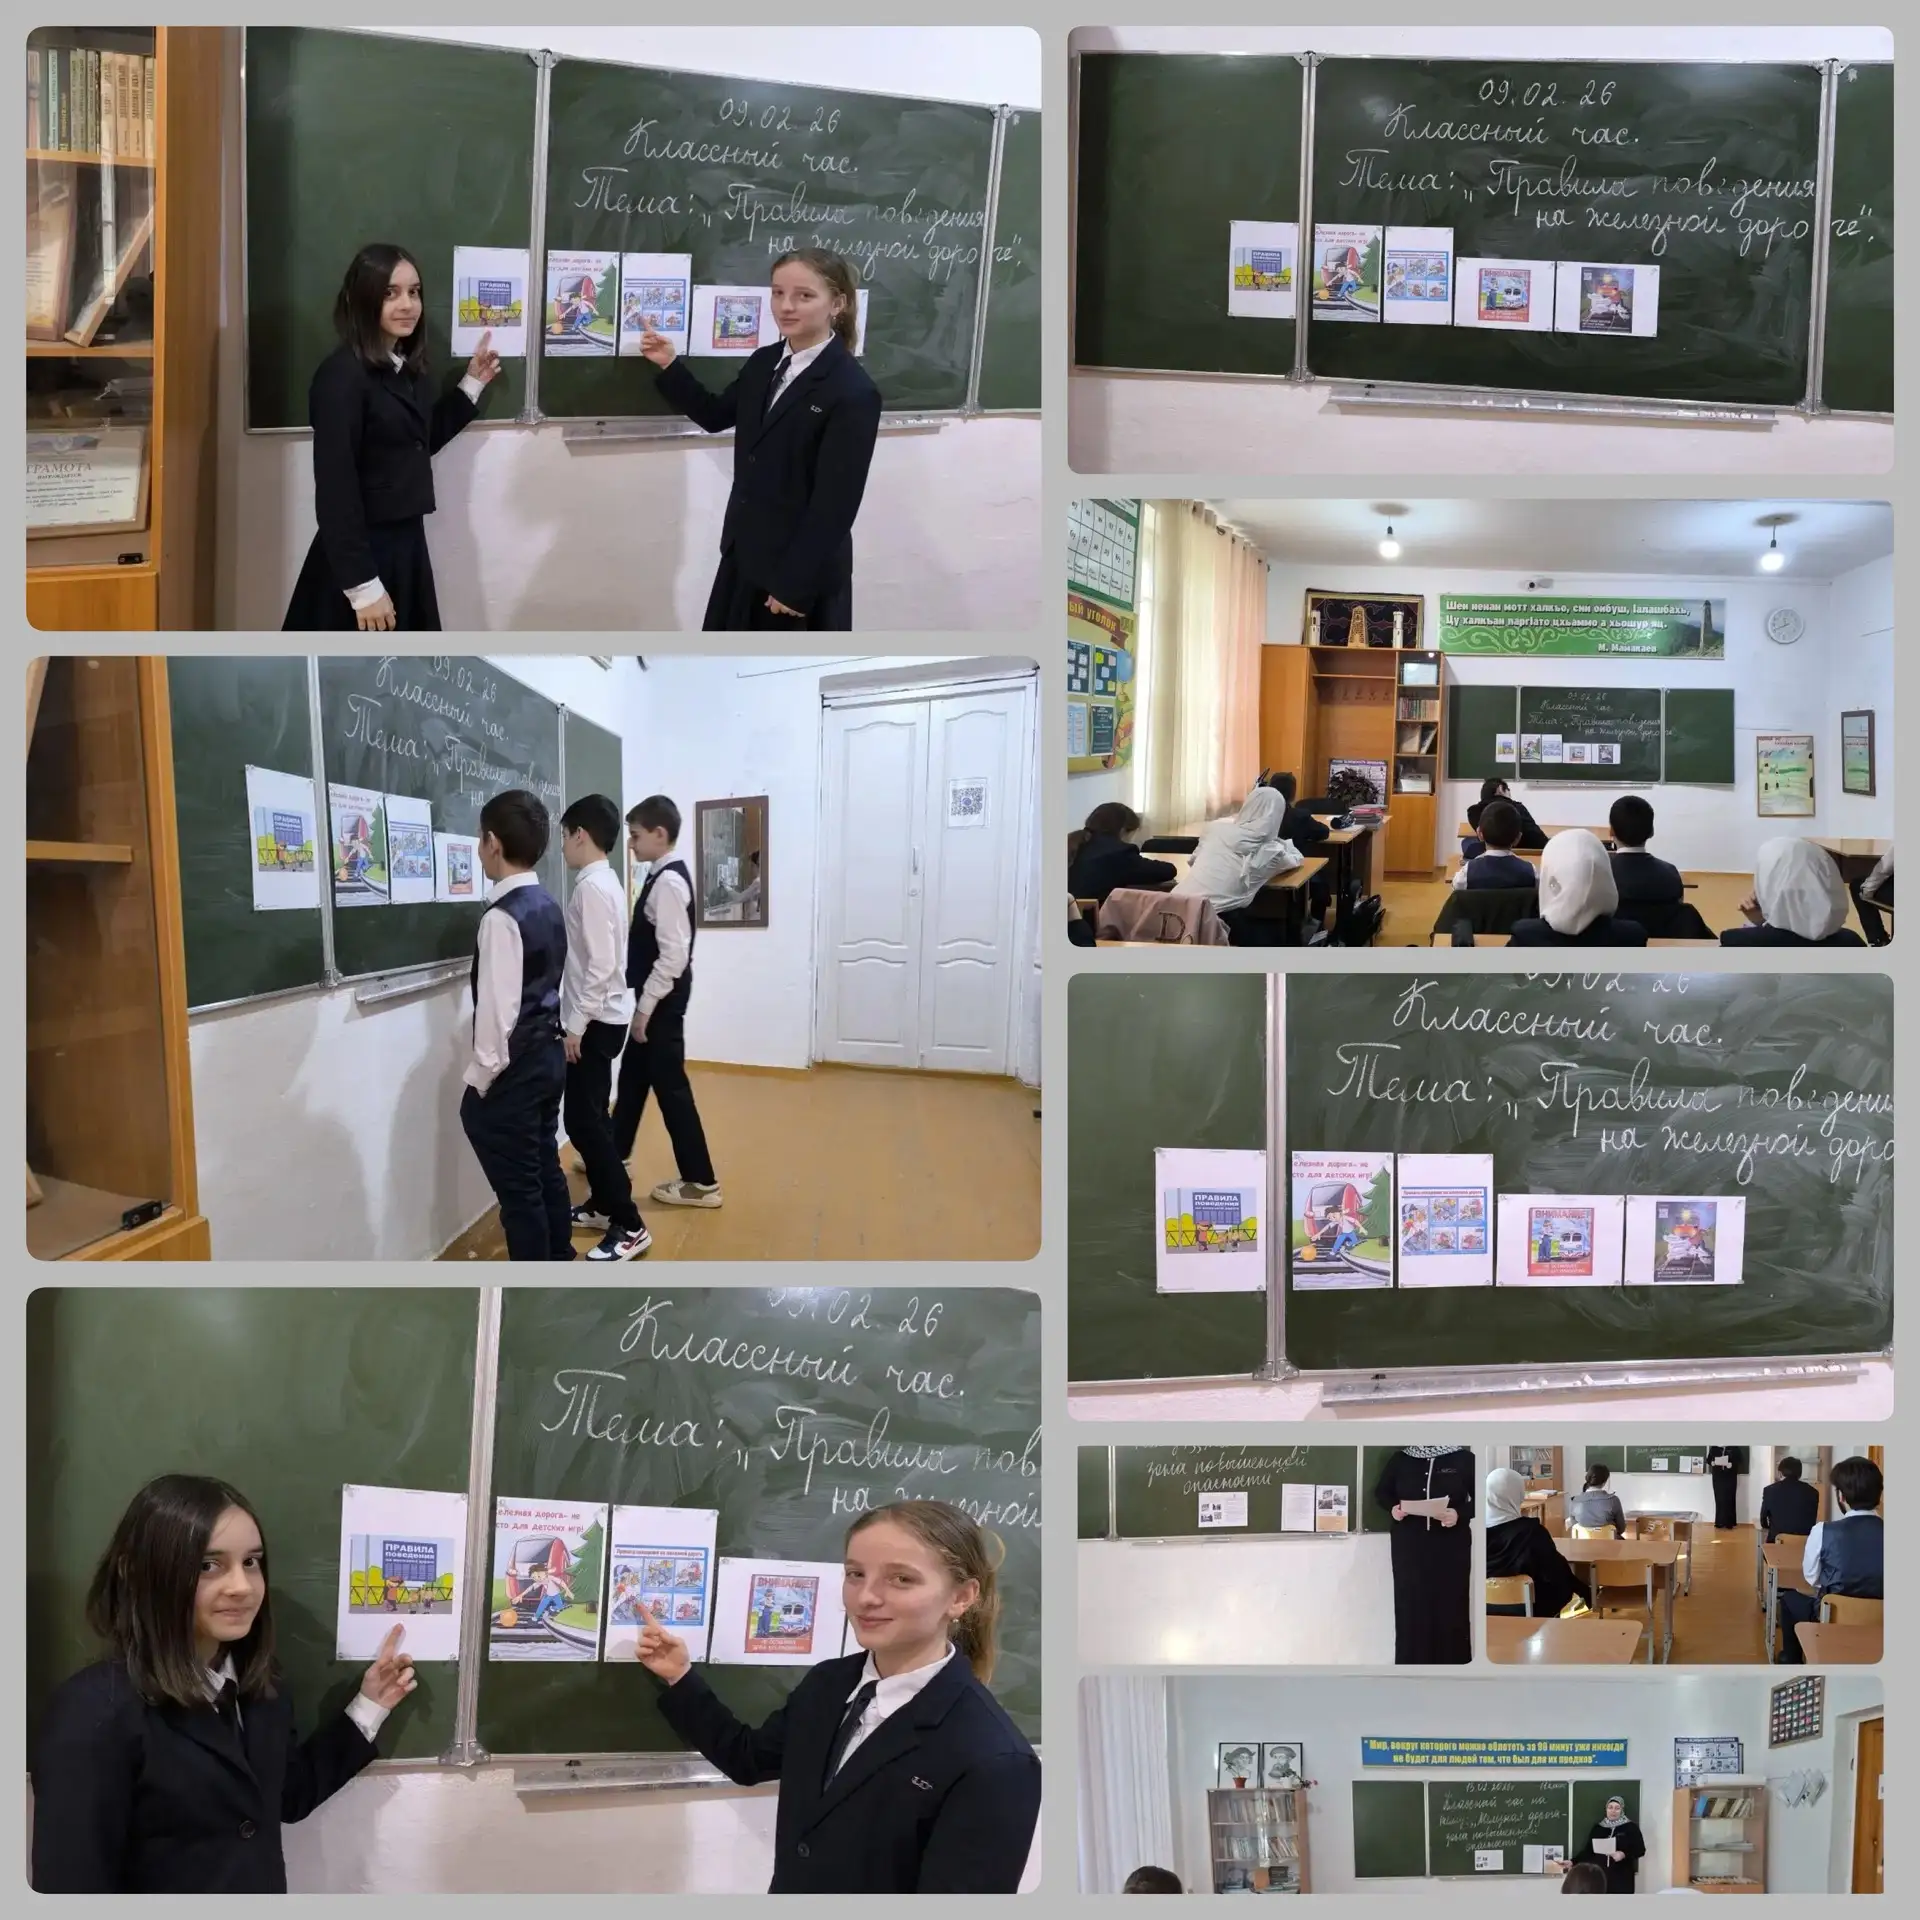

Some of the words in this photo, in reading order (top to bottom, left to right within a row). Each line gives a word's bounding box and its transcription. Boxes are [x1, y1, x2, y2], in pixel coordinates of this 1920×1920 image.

[623, 116, 783, 170] Классный
[802, 151, 859, 175] час.
[1383, 102, 1550, 144] Классный
[1571, 126, 1640, 147] час.
[574, 166, 695, 214] Тема:
[1338, 148, 1454, 191] Тема:
[768, 234, 798, 255] на
[1536, 206, 1576, 230] на
[1585, 205, 1727, 257] железной
[1600, 619, 1607, 627] а
[376, 656, 472, 728] Классный
[481, 717, 509, 742] час.
[344, 694, 428, 760] Тема:
[1393, 978, 1616, 1042] Классный
[1643, 1020, 1723, 1047] час.
[1327, 1042, 1493, 1103] Тема:
[1601, 1126, 1647, 1153] на
[1662, 1123, 1816, 1186] железной
[1194, 1194, 1239, 1202] ПРАВИЛА
[619, 1295, 858, 1385] Классный
[885, 1364, 965, 1399] час.
[540, 1368, 724, 1450] Тема:
[832, 1485, 880, 1515] на
[385, 1543, 434, 1554] ПРАВИЛА
[531, 1523, 565, 1532] детских
[1390, 1741, 1418, 1751] вокруг
[1420, 1741, 1457, 1751] которого
[1458, 1742, 1486, 1751] можно
[1526, 1743, 1537, 1752] за
[1549, 1742, 1574, 1752] минут
[1574, 1743, 1591, 1752] уже
[1591, 1742, 1625, 1752] никогда
[1393, 1754, 1404, 1763] не
[1405, 1753, 1430, 1764] будет
[1431, 1755, 1448, 1764] для
[1448, 1753, 1478, 1764] людей
[1497, 1755, 1511, 1764] что
[1512, 1754, 1530, 1763] был
[1530, 1755, 1547, 1764] для
[1547, 1755, 1558, 1763] их
